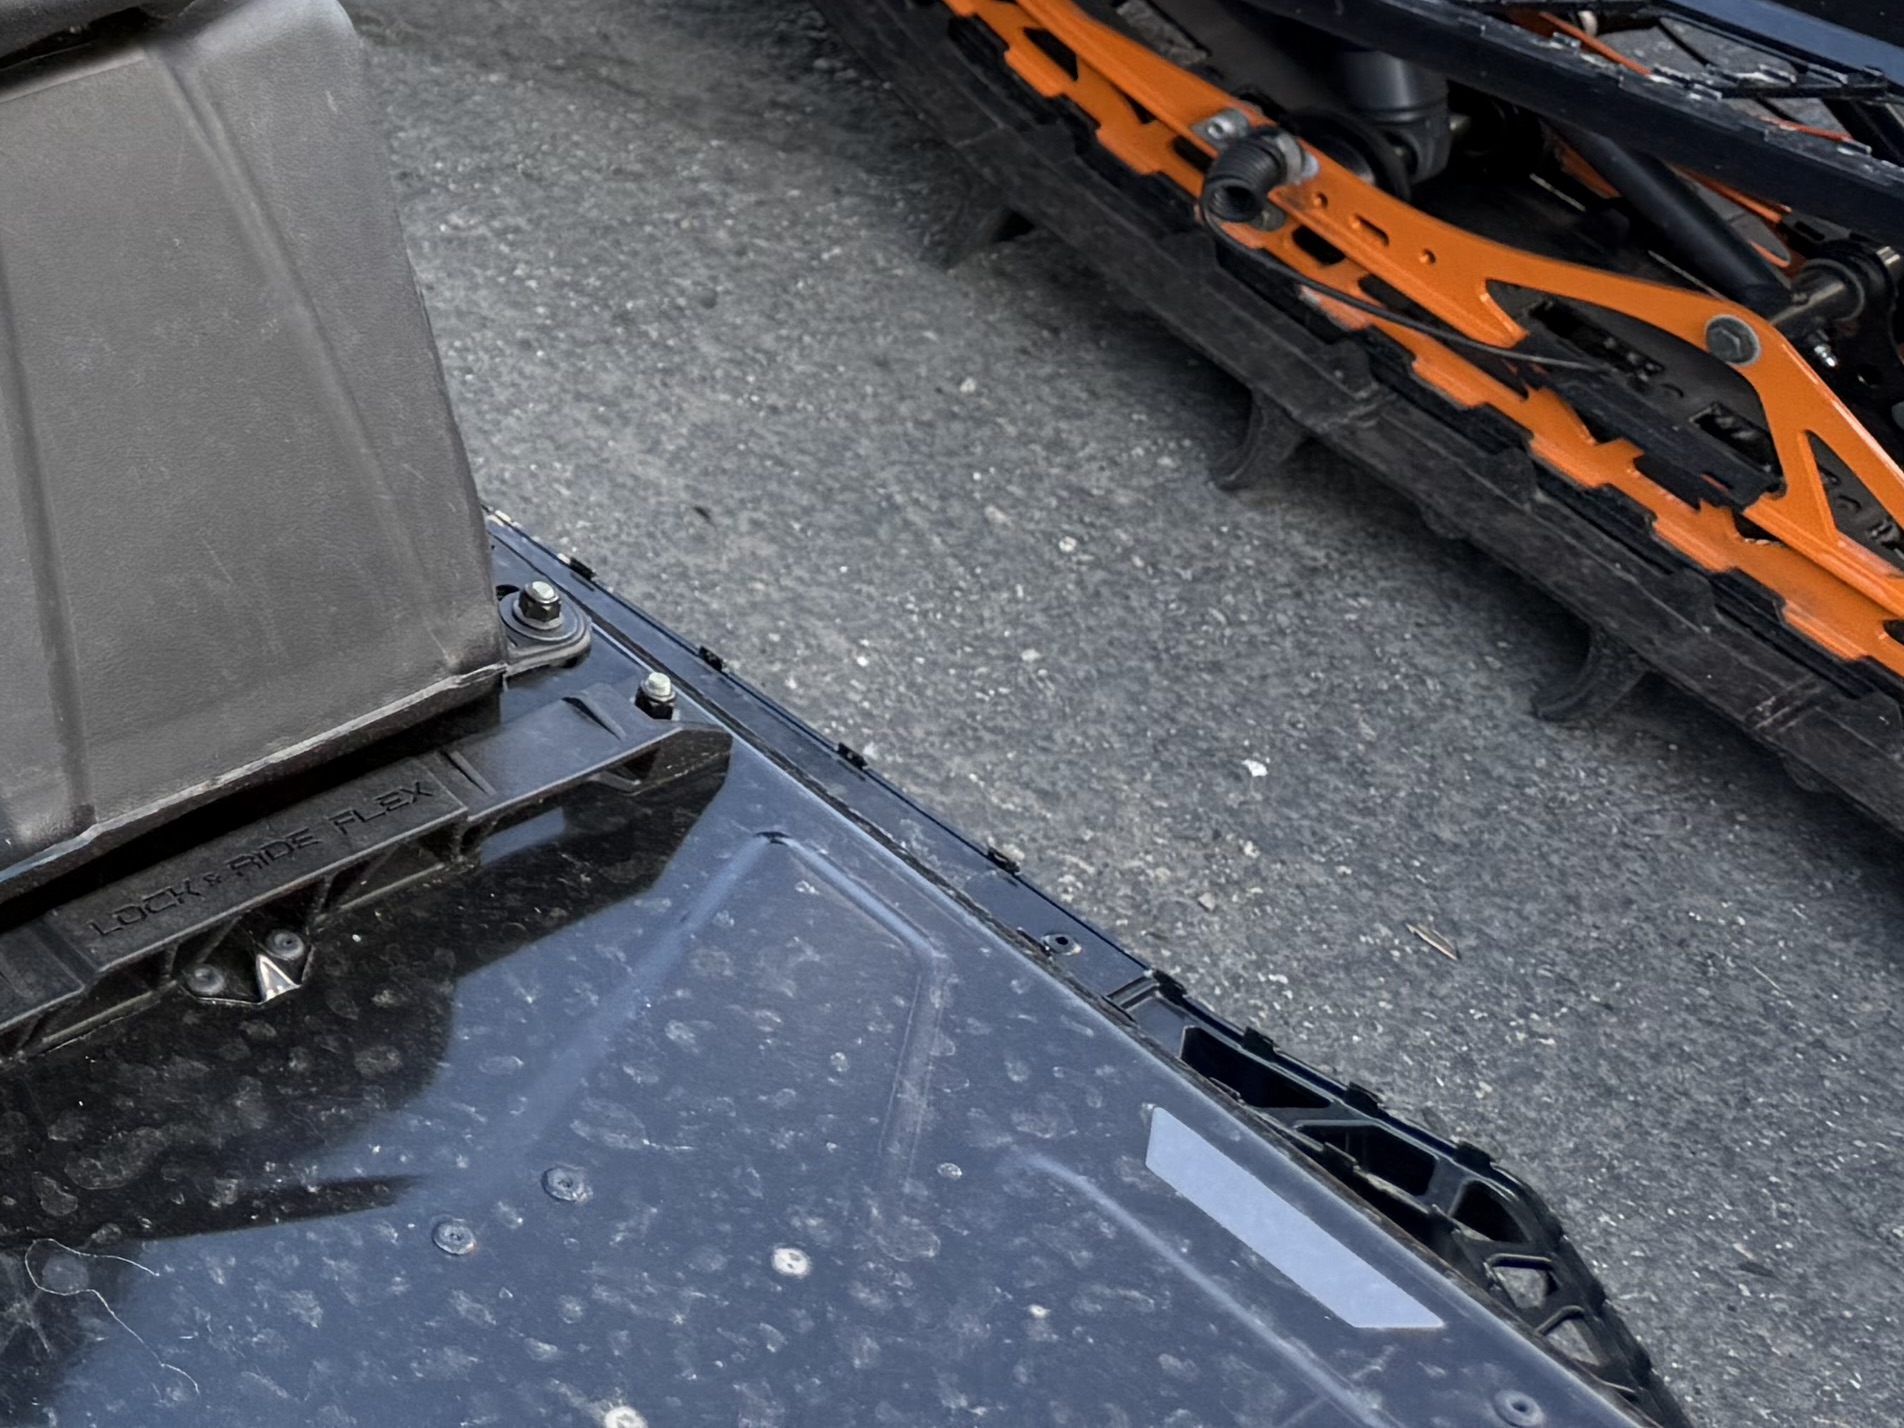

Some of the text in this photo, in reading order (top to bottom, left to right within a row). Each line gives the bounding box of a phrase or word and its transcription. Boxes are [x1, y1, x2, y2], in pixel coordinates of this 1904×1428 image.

[88, 878, 201, 936] LOCK
[226, 828, 321, 877] RIDE
[328, 781, 433, 834] FLEX
